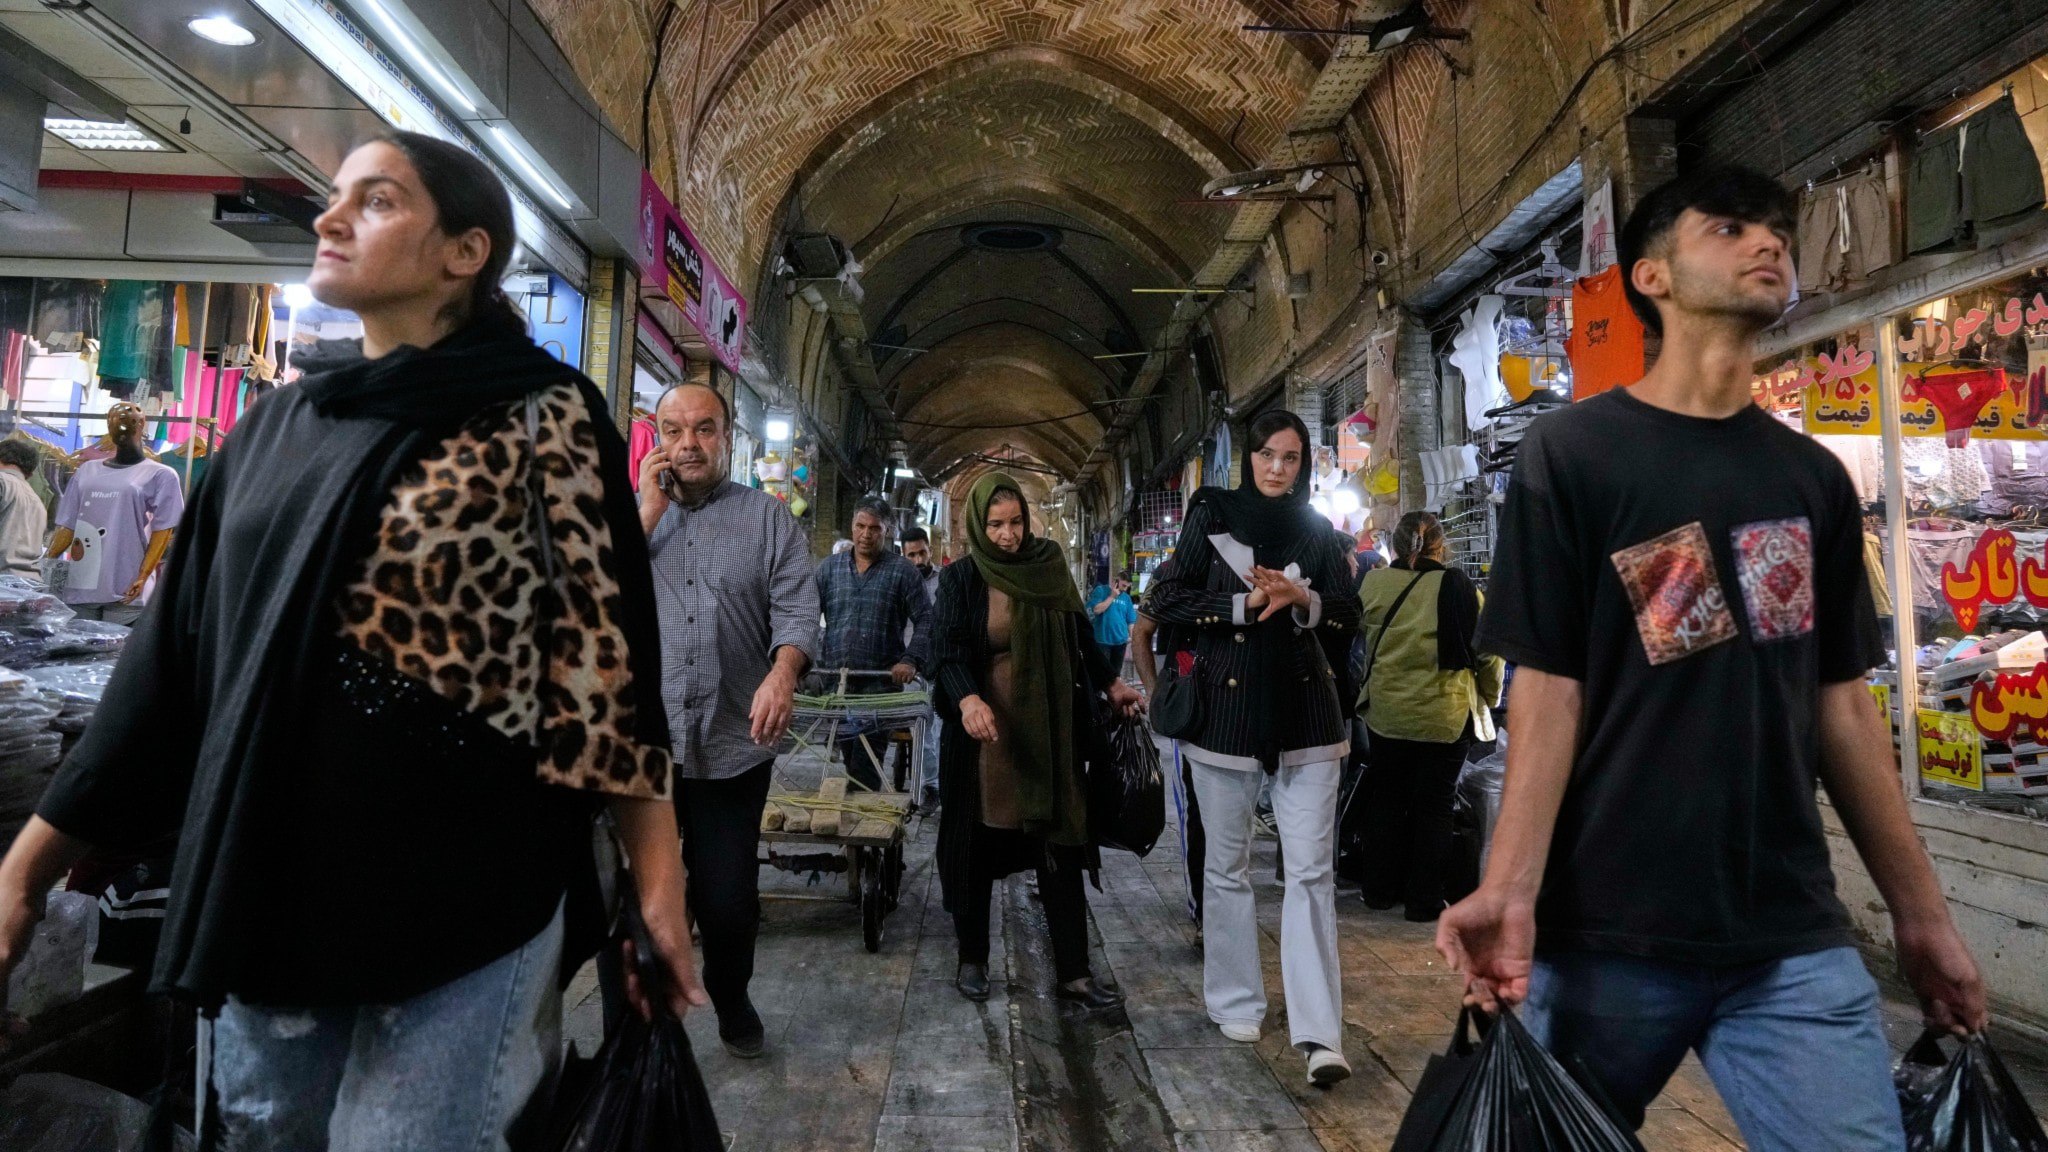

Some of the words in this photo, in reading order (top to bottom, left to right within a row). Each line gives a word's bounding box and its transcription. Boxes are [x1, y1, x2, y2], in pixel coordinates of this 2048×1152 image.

[335, 10, 365, 44] akpai
[376, 49, 402, 80] akpai
[410, 84, 434, 111] akpai
[1897, 307, 1988, 362] جوراب
[1815, 400, 1871, 428] قیمت
[1900, 402, 1937, 430] قیم
[1944, 534, 2016, 628] تاپ
[1922, 748, 1973, 779] تولیدی
